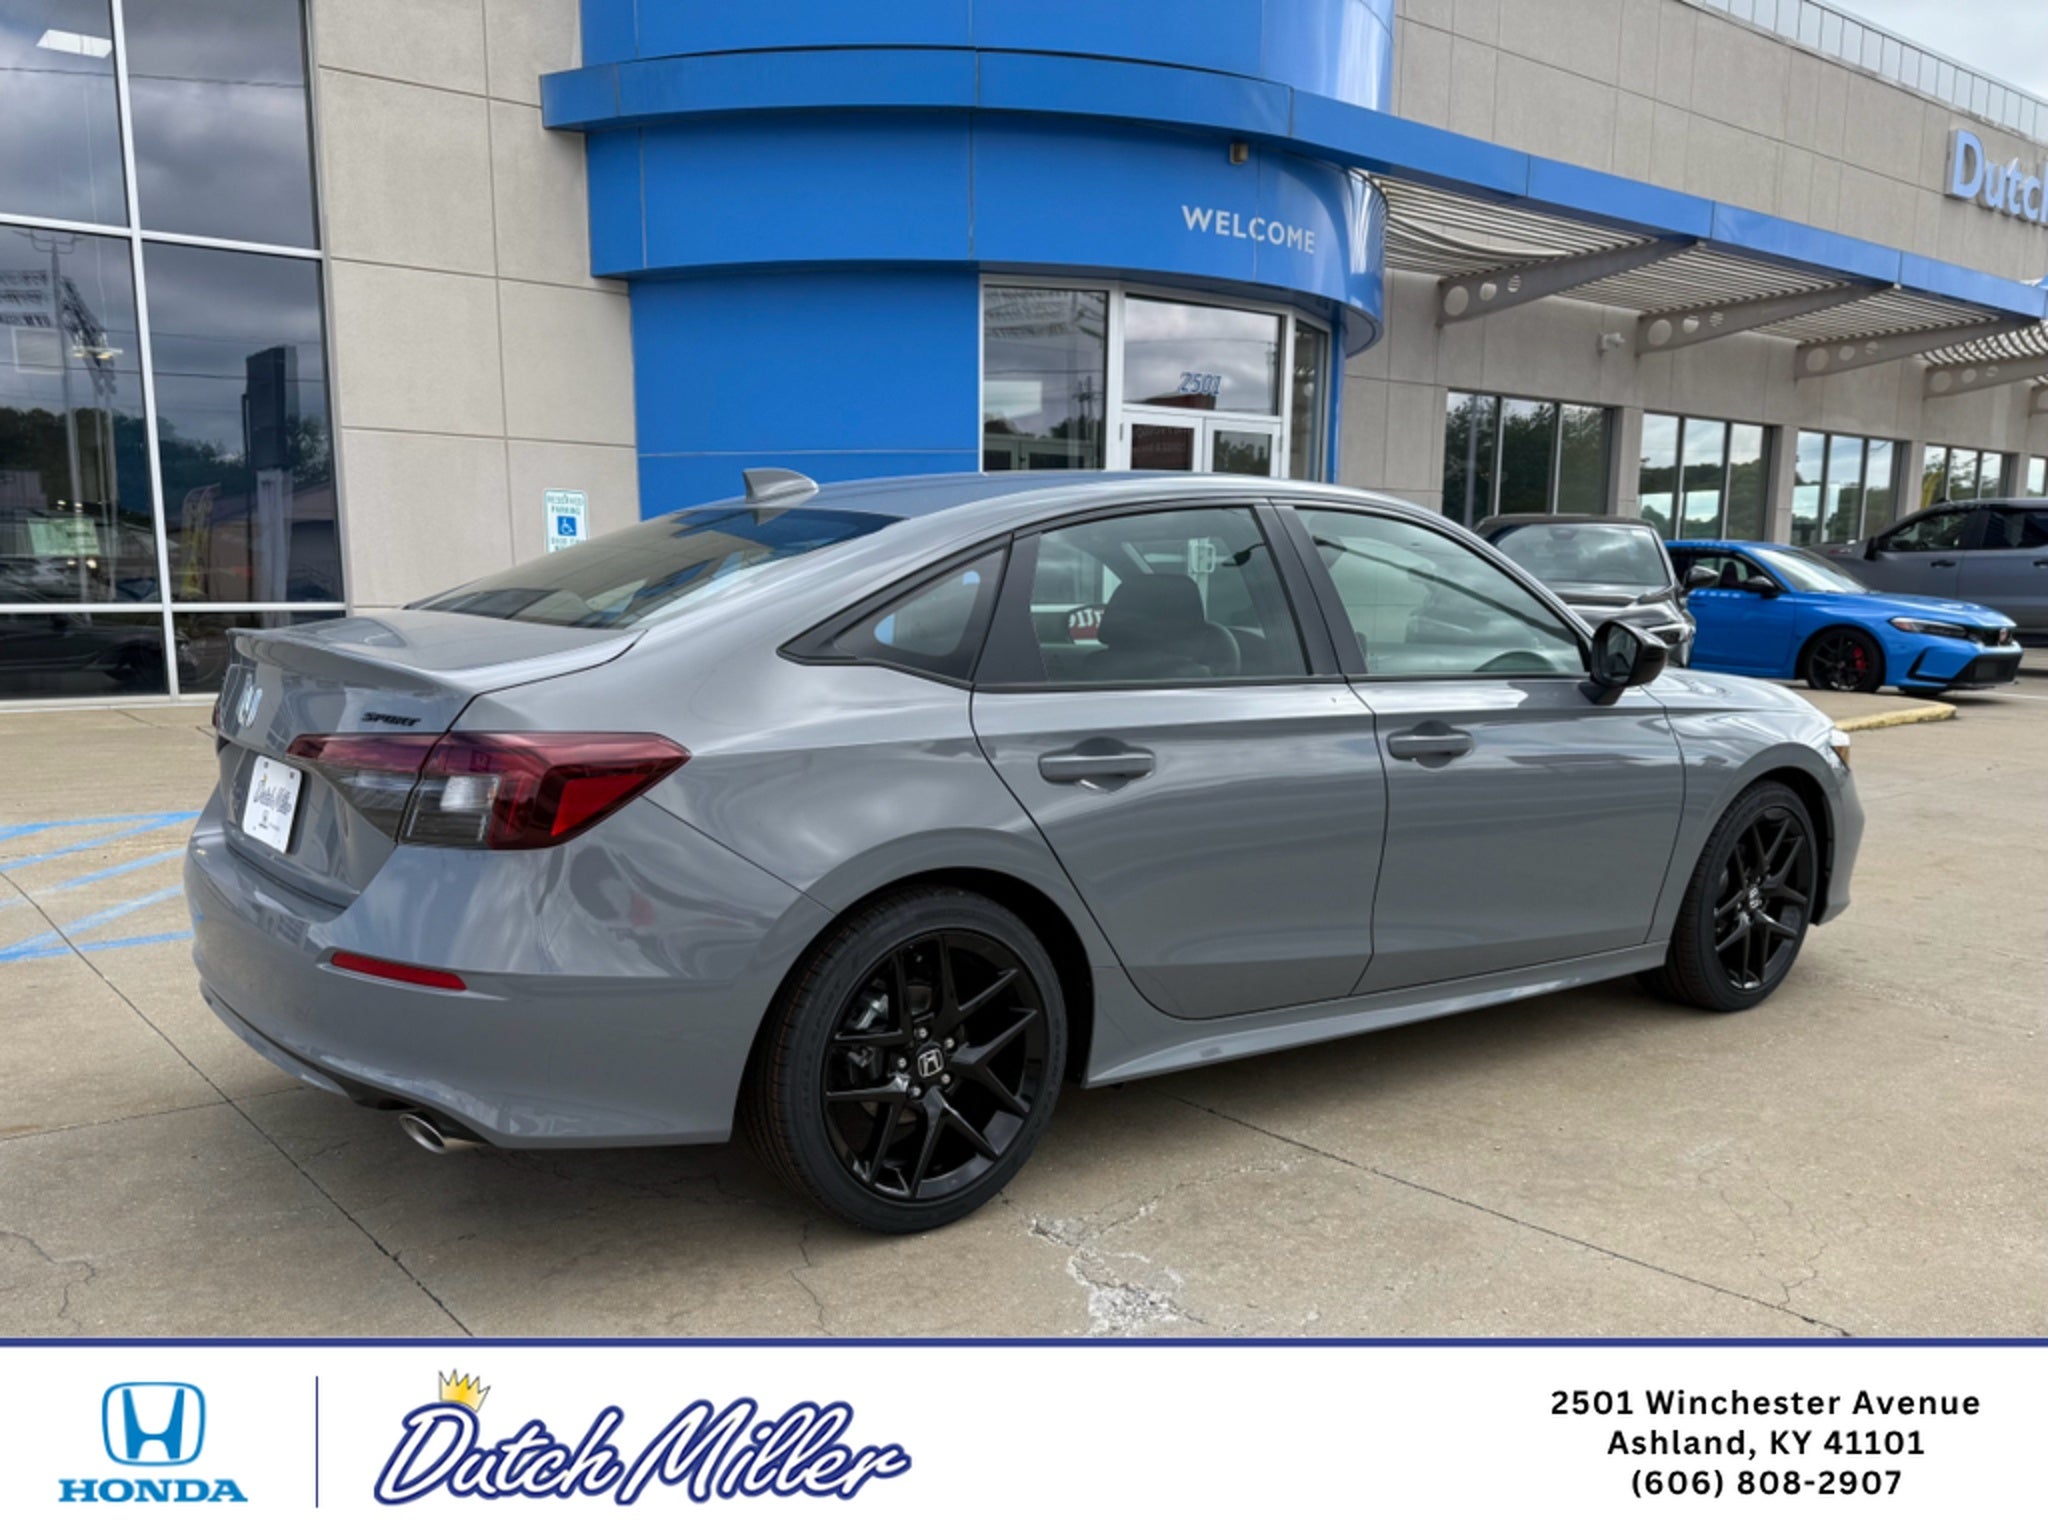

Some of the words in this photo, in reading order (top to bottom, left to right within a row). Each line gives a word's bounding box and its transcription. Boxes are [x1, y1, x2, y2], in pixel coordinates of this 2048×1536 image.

[1182, 204, 1316, 254] WELCOME
[1178, 371, 1222, 395] 2501
[361, 711, 422, 727] SPORT
